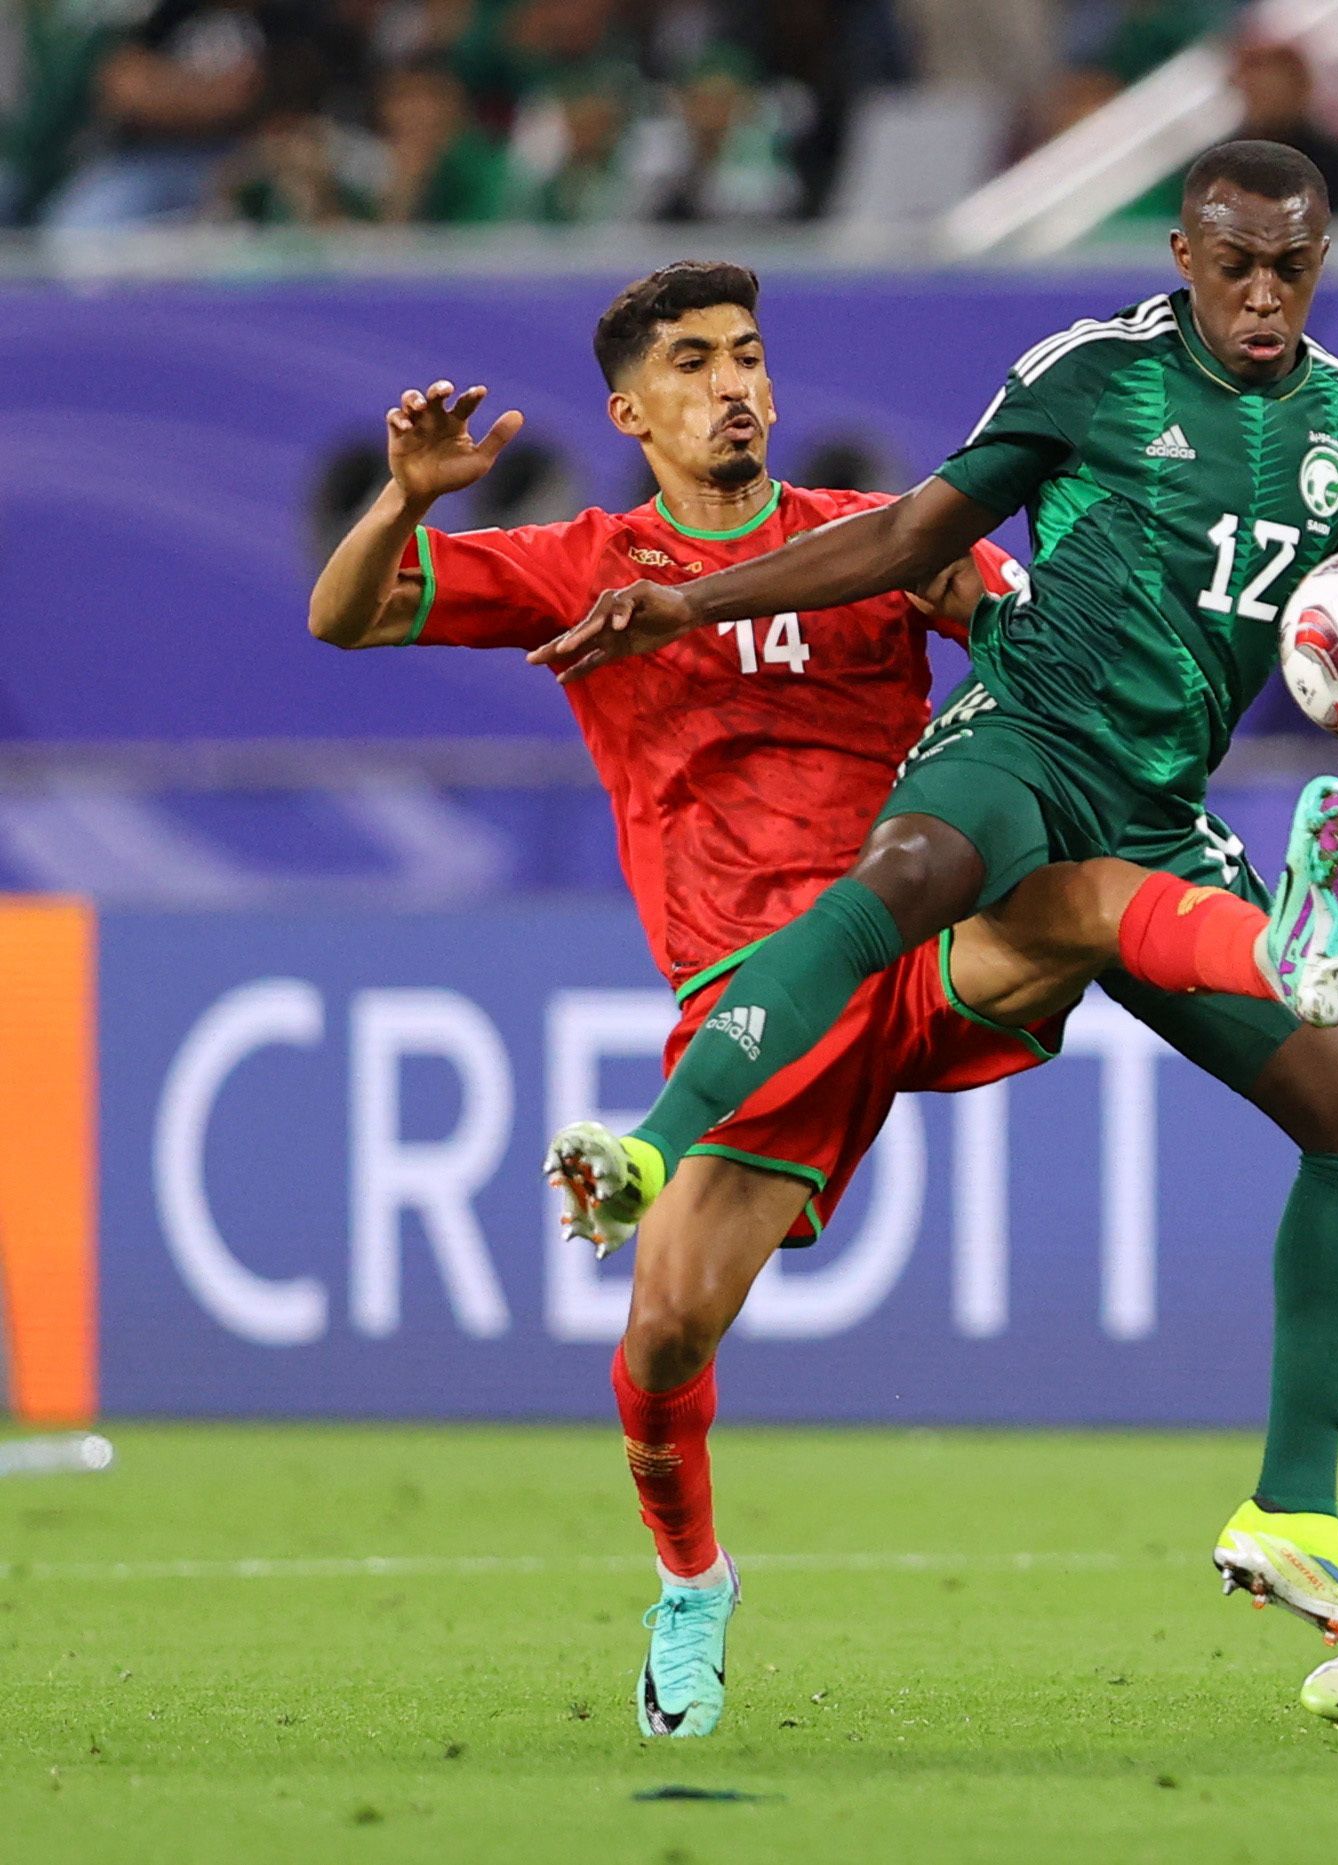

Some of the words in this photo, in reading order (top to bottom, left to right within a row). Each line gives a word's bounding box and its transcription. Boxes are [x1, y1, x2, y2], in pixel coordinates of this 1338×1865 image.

[1145, 444, 1196, 460] adidas
[628, 546, 703, 574] Kaa
[1197, 513, 1300, 622] 12
[717, 612, 810, 674] 14
[705, 1016, 761, 1062] adidas
